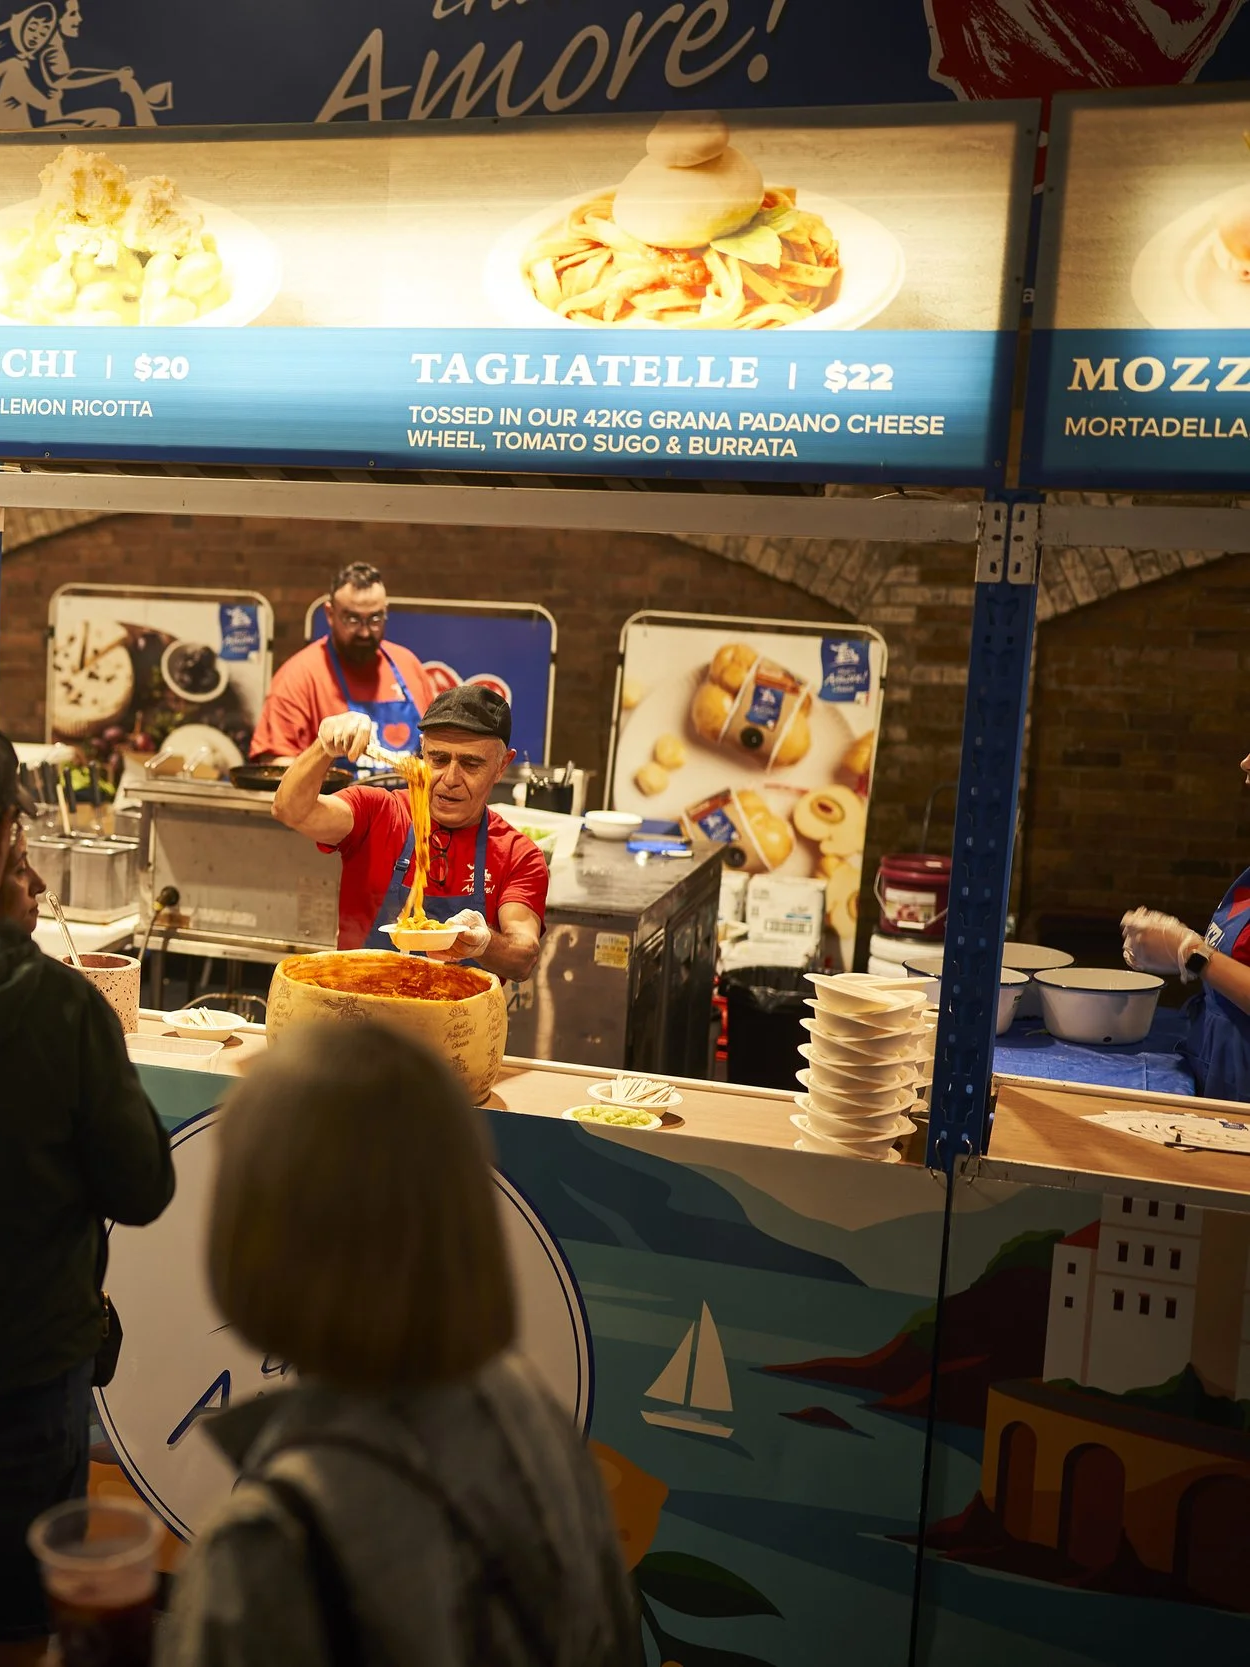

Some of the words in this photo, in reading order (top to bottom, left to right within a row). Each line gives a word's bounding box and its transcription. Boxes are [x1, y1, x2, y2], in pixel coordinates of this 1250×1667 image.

[313, 0, 786, 123] Amore!
[134, 352, 190, 382] $20
[411, 352, 759, 390] TAGLIATELLE
[823, 359, 894, 394] $22
[1066, 355, 1250, 392] MOZZ
[0, 398, 67, 416] LEMON
[71, 400, 153, 418] RICOTTA
[409, 405, 495, 426] TOSSED
[500, 406, 523, 426] IN
[527, 407, 577, 428] OUR
[583, 408, 643, 429] 42KG
[649, 410, 733, 431] GRANA
[738, 411, 840, 433] PADANO
[846, 414, 945, 436] CHEESE
[407, 430, 486, 452] WHEEL,
[492, 431, 588, 452] TOMATO
[592, 433, 660, 454] SUGO
[665, 434, 682, 455] &
[688, 435, 798, 457] BURRATA
